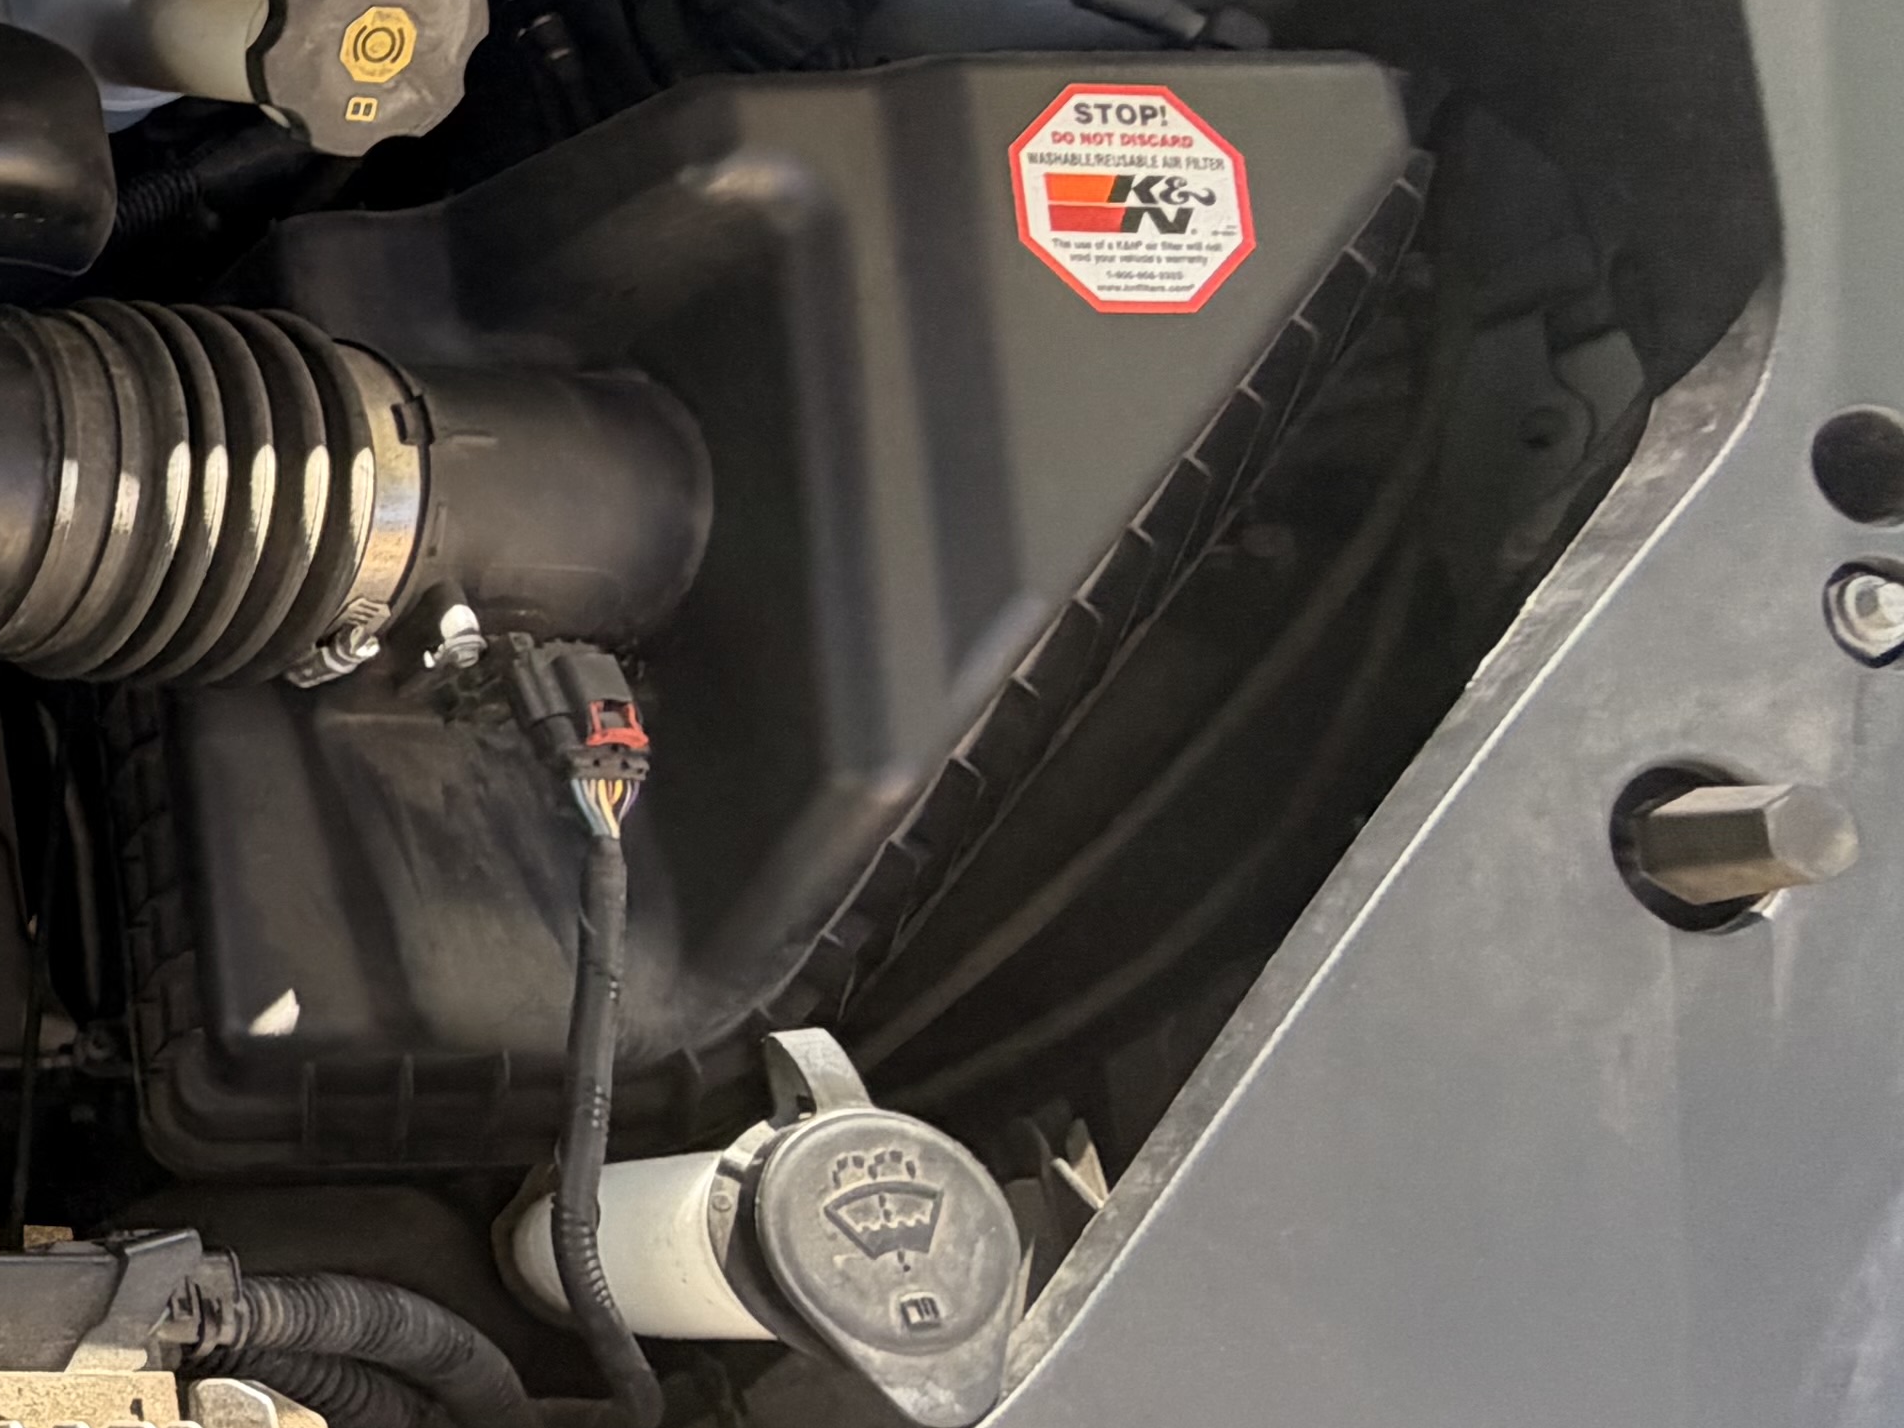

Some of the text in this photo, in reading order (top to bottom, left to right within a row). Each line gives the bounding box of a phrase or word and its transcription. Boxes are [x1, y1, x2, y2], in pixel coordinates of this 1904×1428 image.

[1074, 103, 1168, 127] STOP!
[1051, 131, 1194, 149] DO NOT DISCARD
[1162, 156, 1182, 169] AIR
[1186, 156, 1225, 171] FILTER
